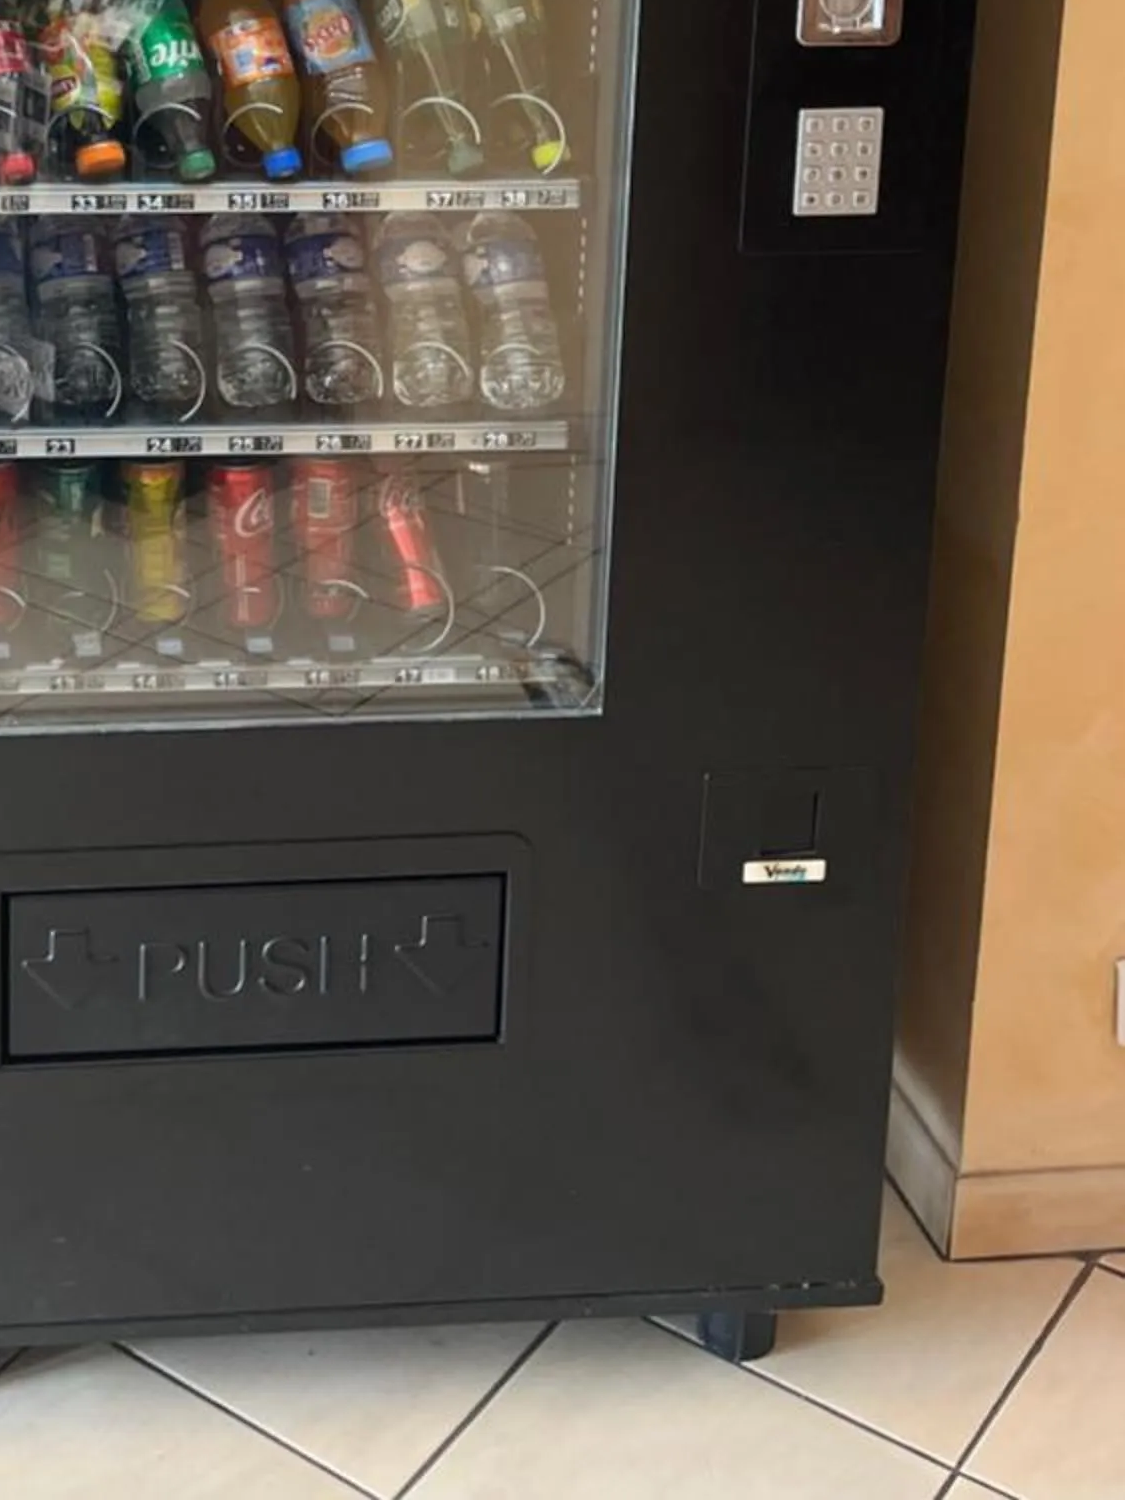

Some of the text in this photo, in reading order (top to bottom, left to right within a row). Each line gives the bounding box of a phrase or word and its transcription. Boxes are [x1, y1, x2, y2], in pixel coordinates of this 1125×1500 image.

[140, 194, 163, 210] 34
[429, 192, 452, 208] 37
[149, 438, 171, 452] 24
[397, 434, 421, 449] 27
[138, 932, 370, 1001] PUSH
